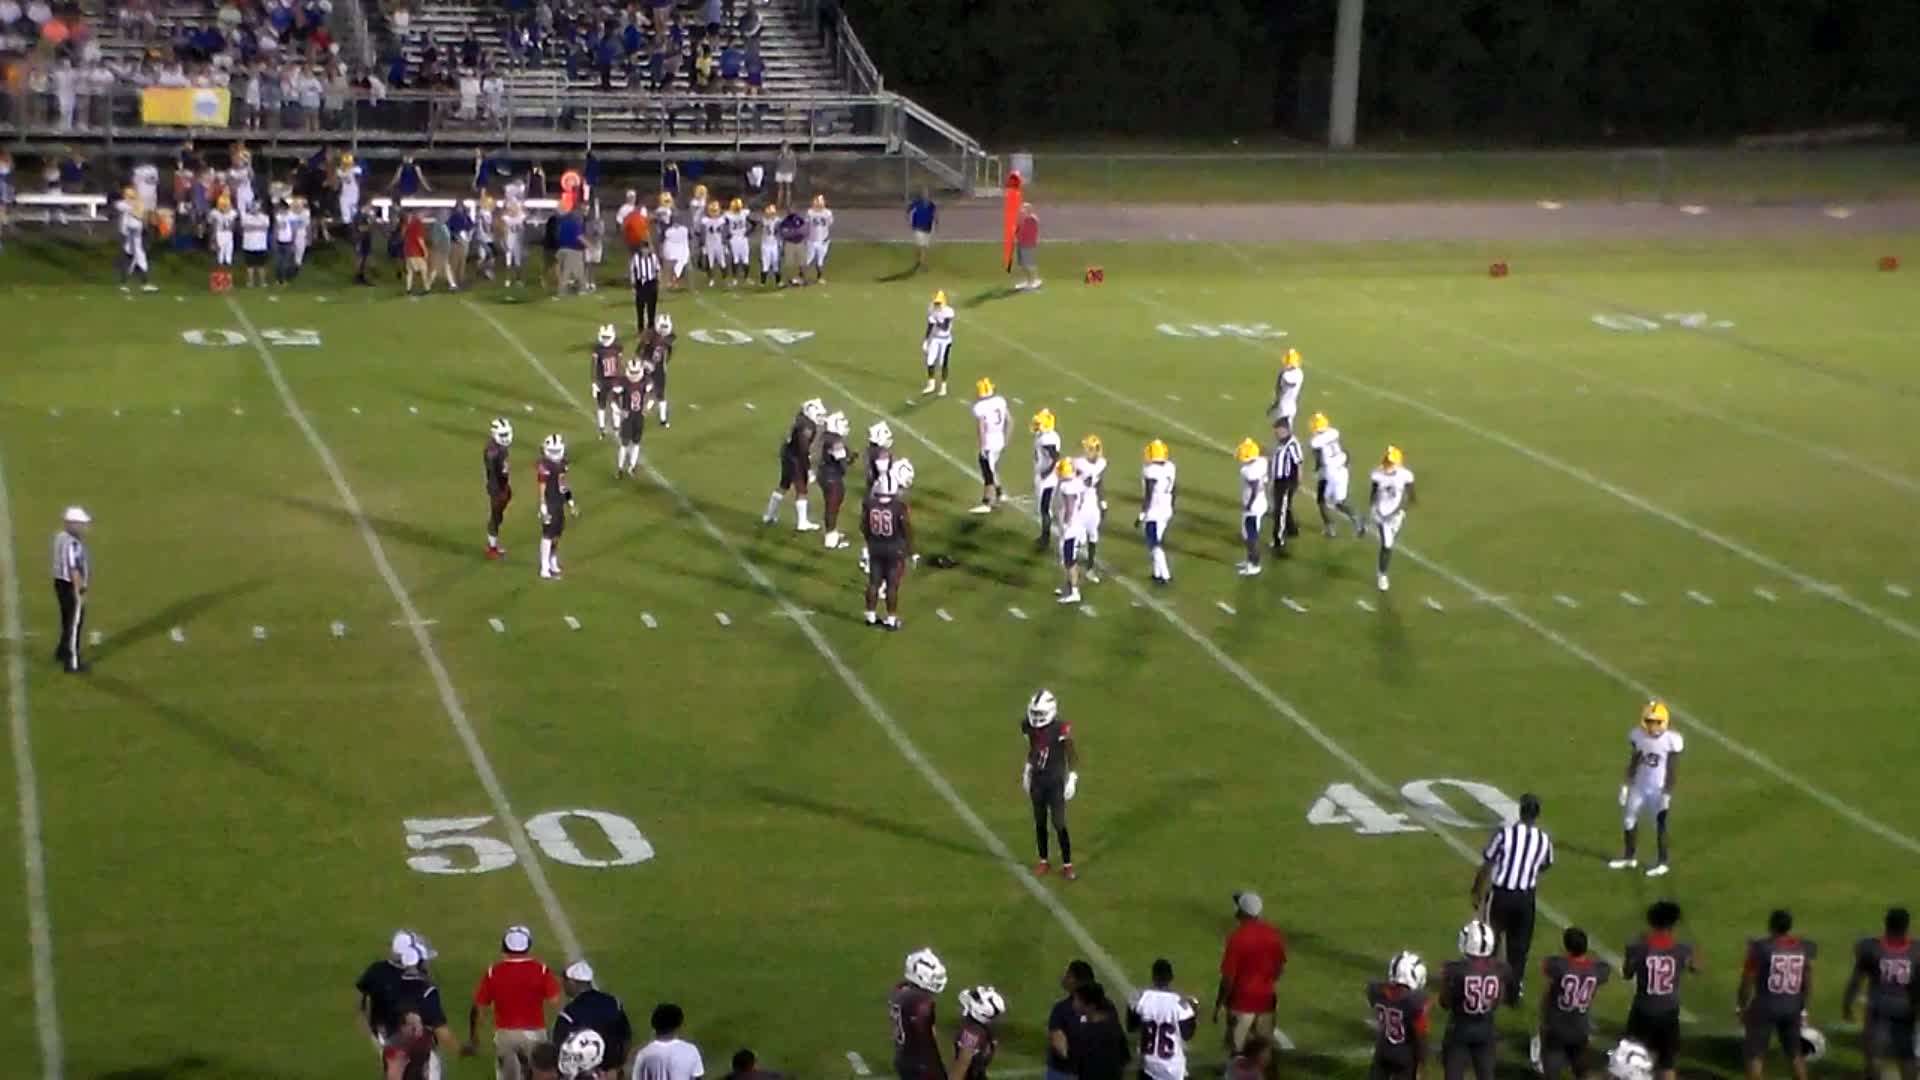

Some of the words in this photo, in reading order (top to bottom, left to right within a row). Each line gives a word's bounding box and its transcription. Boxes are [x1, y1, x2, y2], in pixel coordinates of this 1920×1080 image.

[182, 328, 321, 346] 50
[689, 328, 815, 345] 40
[870, 508, 893, 536] 66
[1307, 778, 1520, 834] 40
[403, 809, 655, 874] 50
[1558, 974, 1597, 1013] 34
[1646, 955, 1675, 994] 12
[1768, 954, 1805, 994] 55
